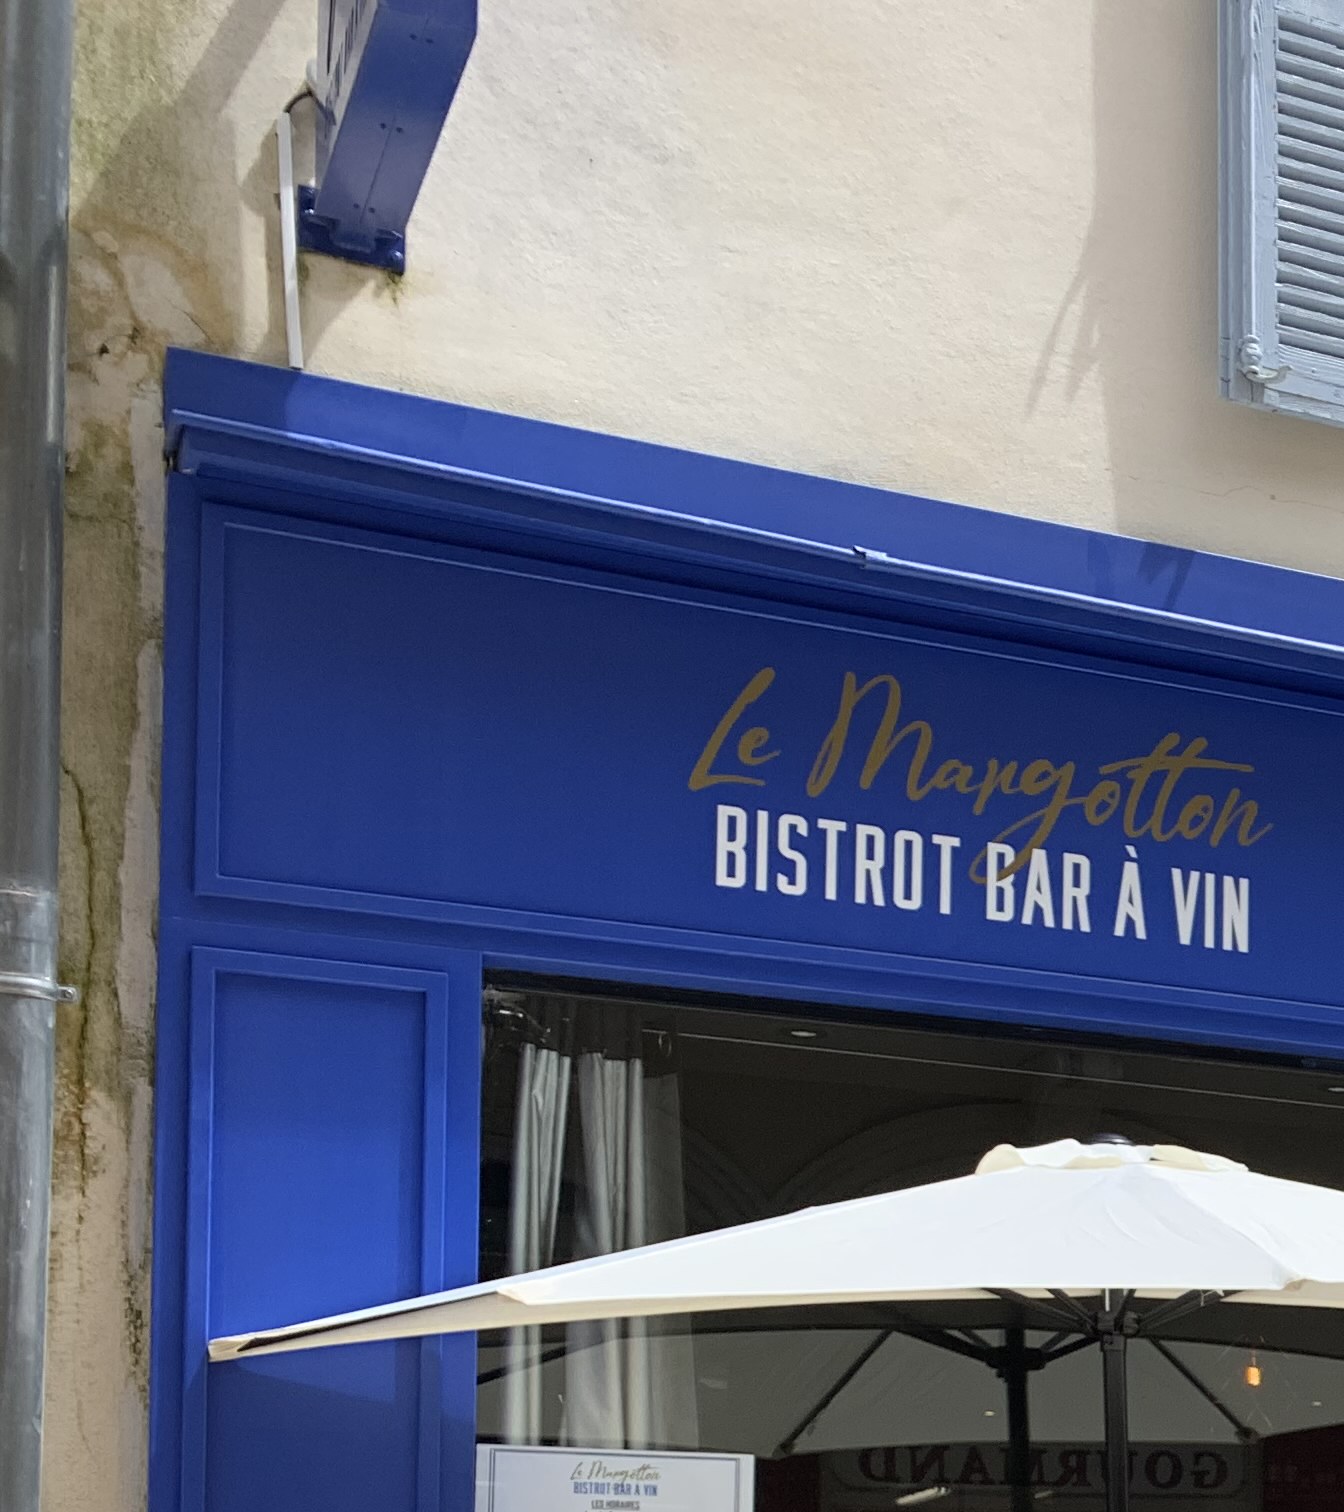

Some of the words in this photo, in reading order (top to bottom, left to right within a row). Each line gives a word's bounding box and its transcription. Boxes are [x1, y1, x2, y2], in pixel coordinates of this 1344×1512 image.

[689, 666, 782, 792] Le
[806, 671, 1274, 884] Margotton
[715, 804, 961, 915] BISTROT
[986, 842, 1091, 933] BAR
[1113, 845, 1148, 940] À
[1171, 867, 1250, 954] VIN
[573, 1482, 610, 1494] BISTROT
[613, 1483, 631, 1495] BAR
[644, 1485, 658, 1496] VIN
